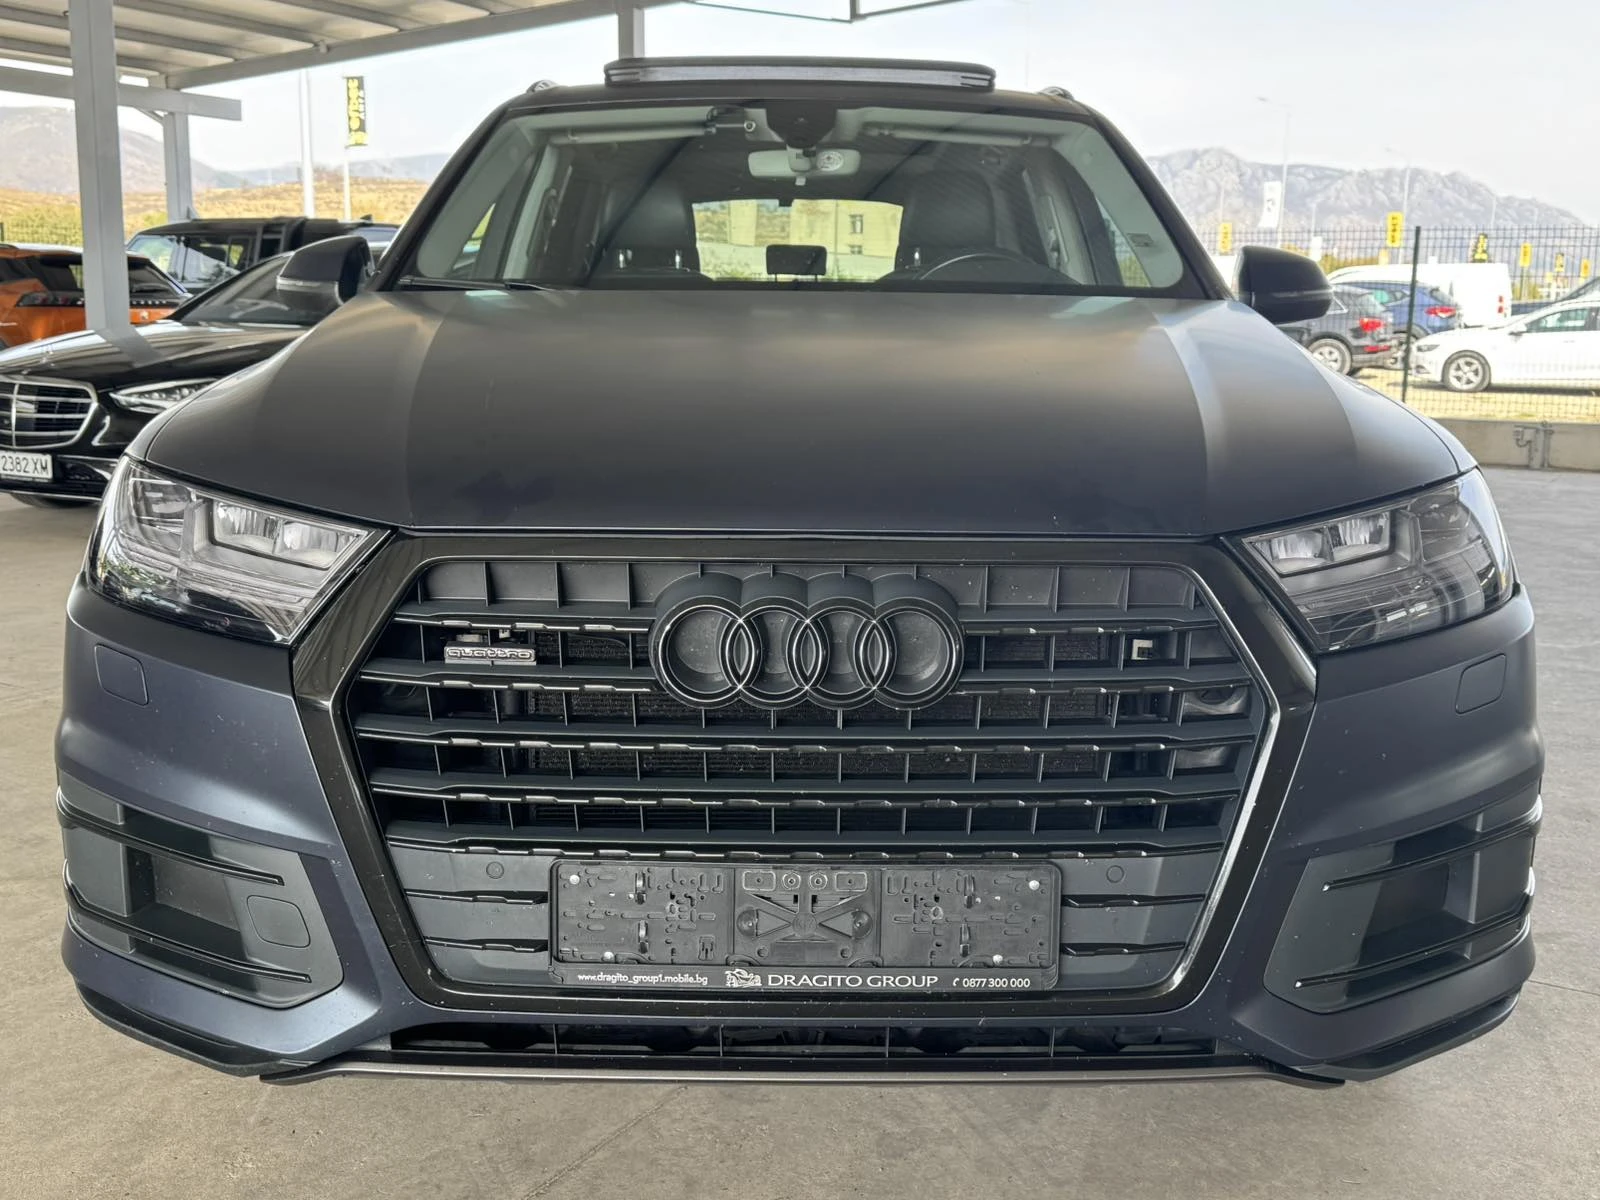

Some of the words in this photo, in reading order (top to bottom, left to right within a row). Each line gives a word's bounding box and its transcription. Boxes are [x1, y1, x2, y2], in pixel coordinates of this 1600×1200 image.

[447, 647, 531, 659] quattro
[768, 974, 863, 988] DRAGITO
[866, 975, 939, 988] GROUP
[962, 978, 987, 988] 0877
[988, 979, 1009, 988] 300
[1010, 979, 1031, 988] 000
